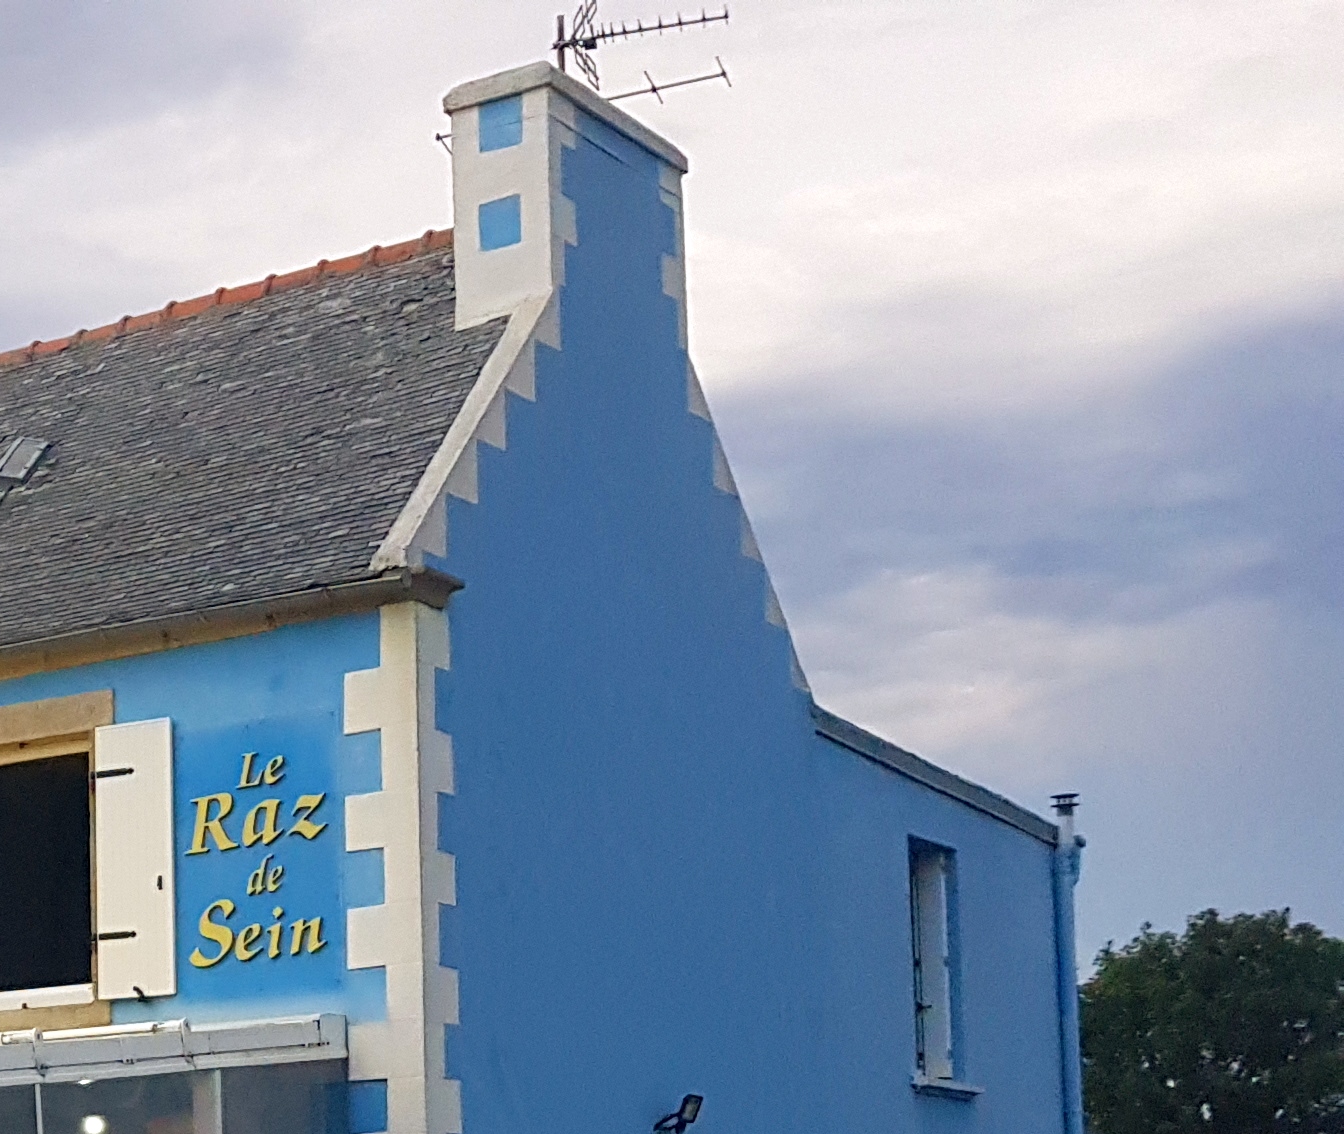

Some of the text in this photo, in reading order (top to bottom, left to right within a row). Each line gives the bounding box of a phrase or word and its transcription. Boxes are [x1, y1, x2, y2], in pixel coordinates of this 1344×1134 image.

[236, 751, 285, 790] Le
[184, 792, 328, 856] Raz
[246, 853, 285, 896] de
[189, 898, 328, 969] Sein
